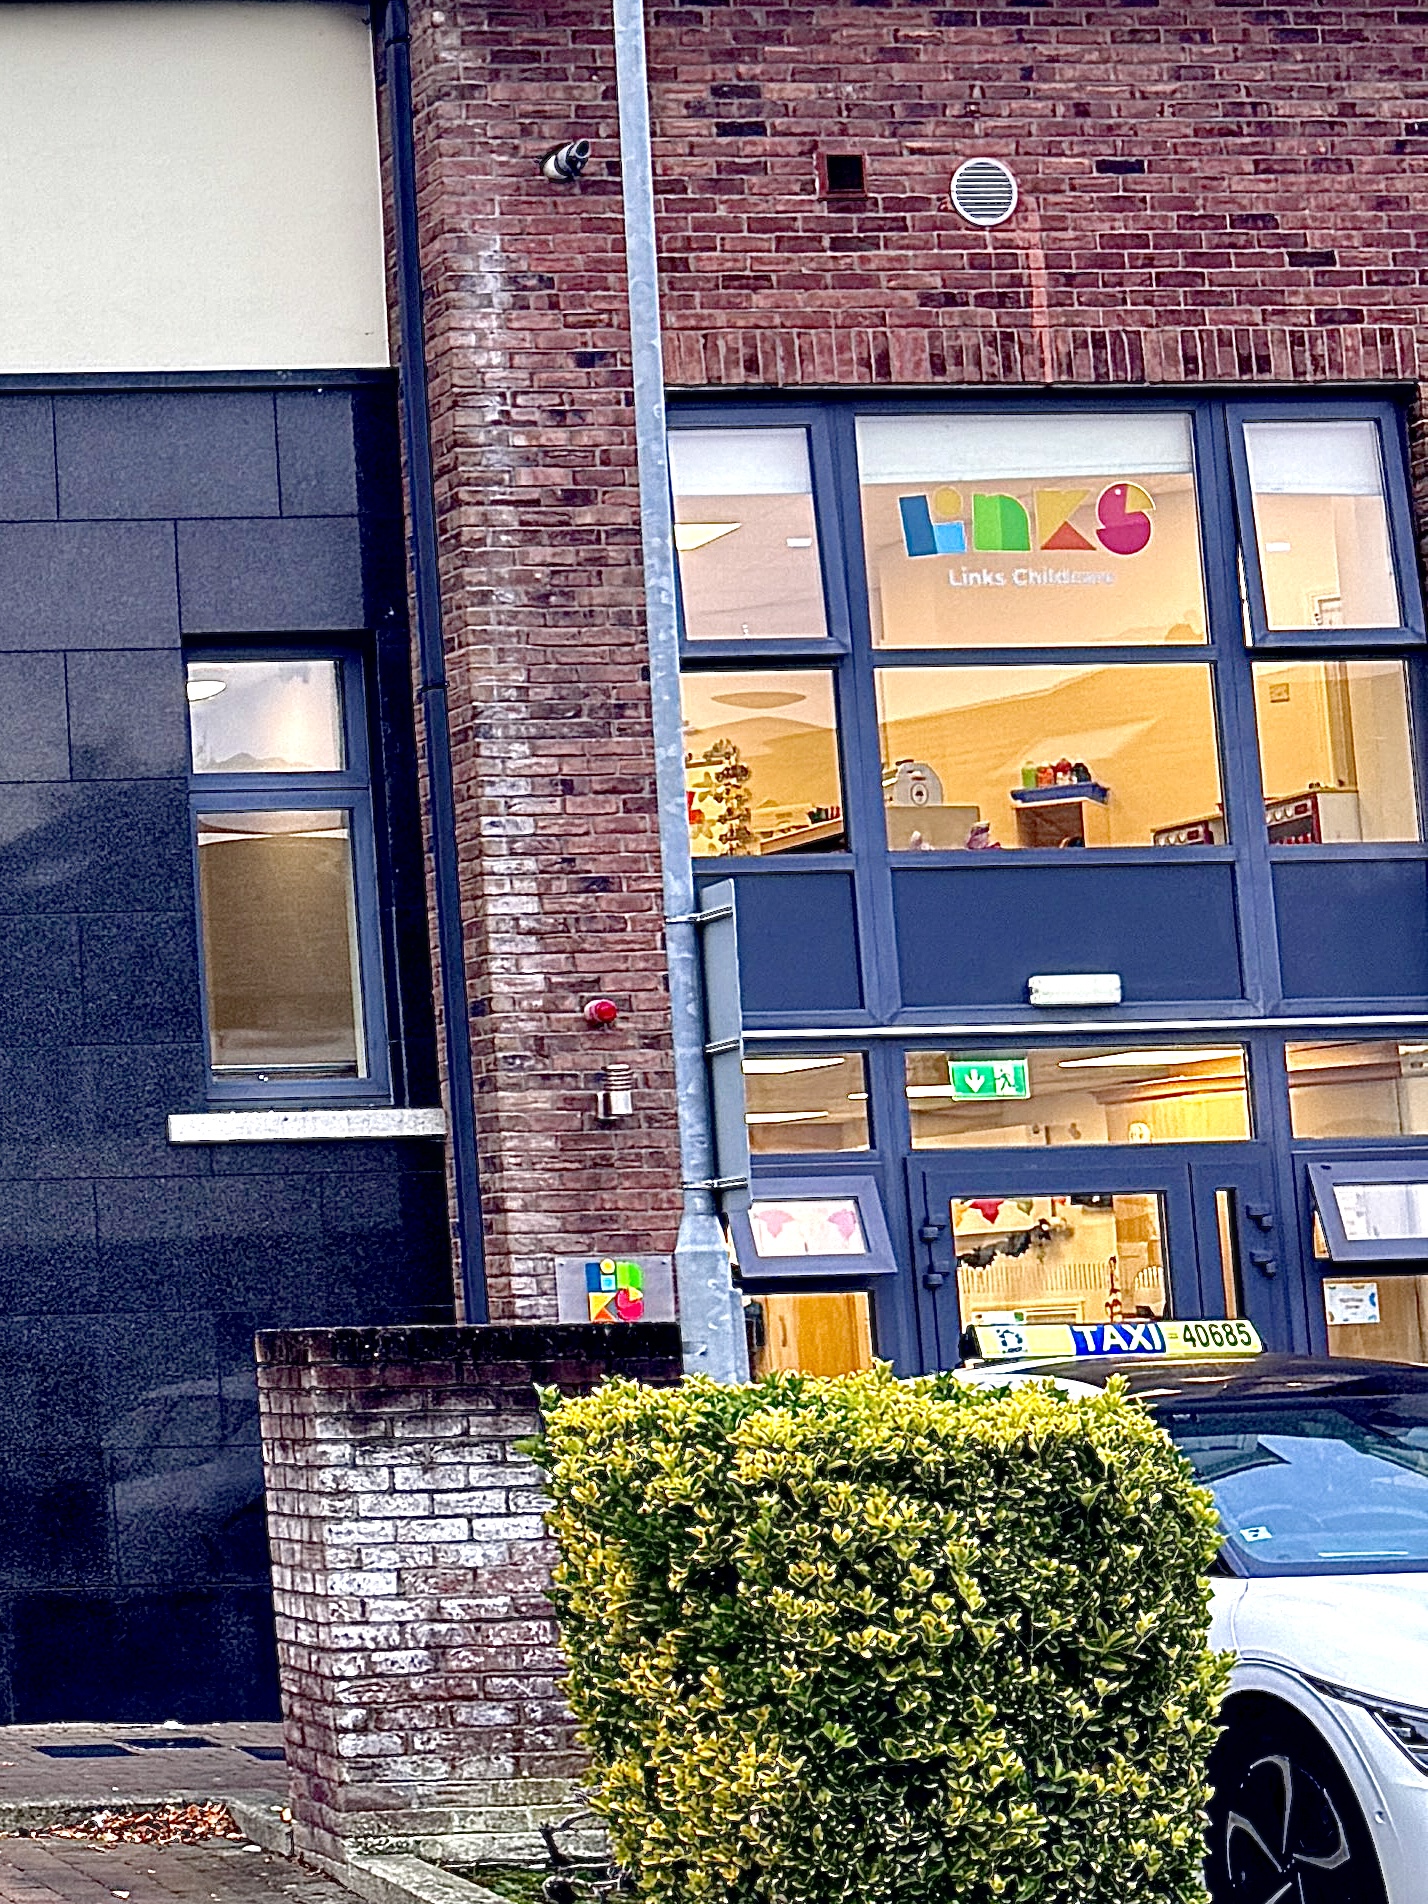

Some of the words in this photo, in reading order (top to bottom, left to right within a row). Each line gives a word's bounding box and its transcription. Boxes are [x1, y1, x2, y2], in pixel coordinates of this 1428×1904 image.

[948, 567, 1004, 586] Links
[1072, 1323, 1163, 1352] TAXI
[1182, 1321, 1253, 1348] 40685
